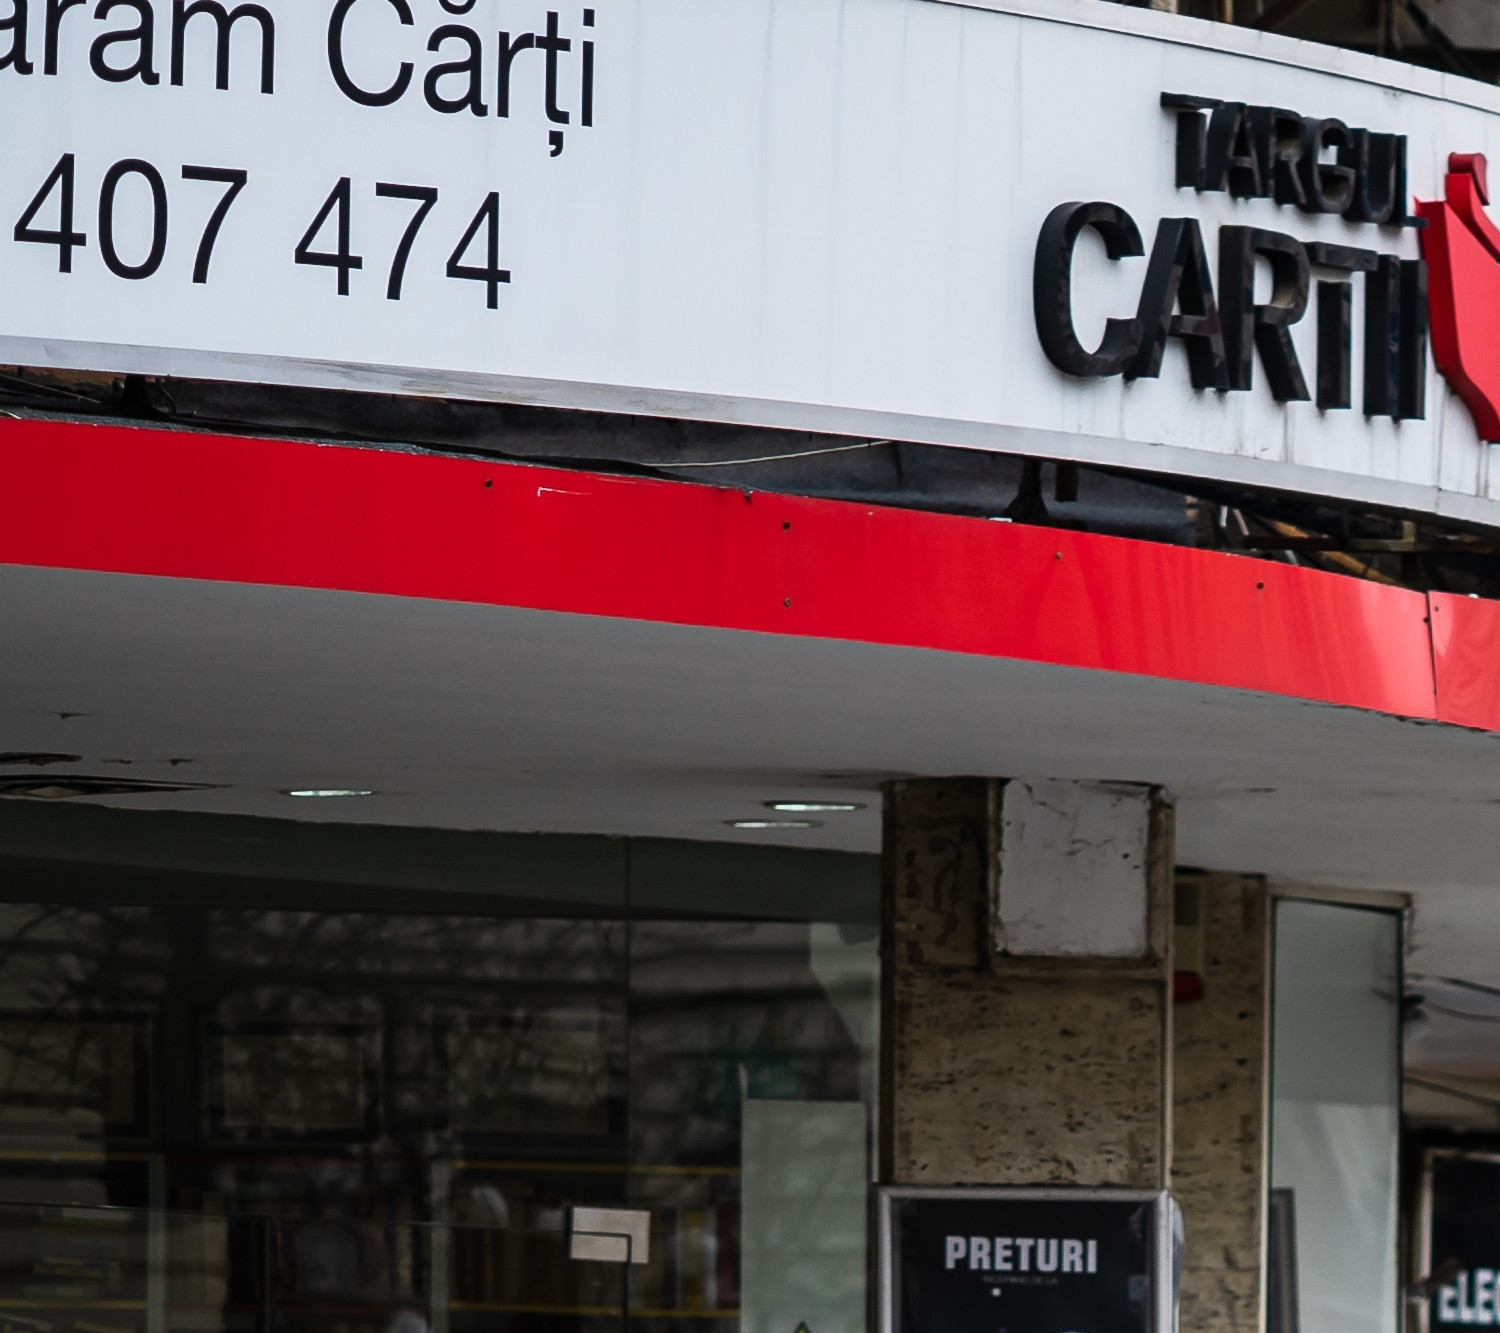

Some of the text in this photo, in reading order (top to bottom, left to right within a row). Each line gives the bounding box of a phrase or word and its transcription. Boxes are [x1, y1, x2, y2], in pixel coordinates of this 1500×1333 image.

[14, 153, 511, 310] 407 474
[1033, 200, 1428, 420] CARTII
[945, 1235, 1098, 1274] PRETURI
